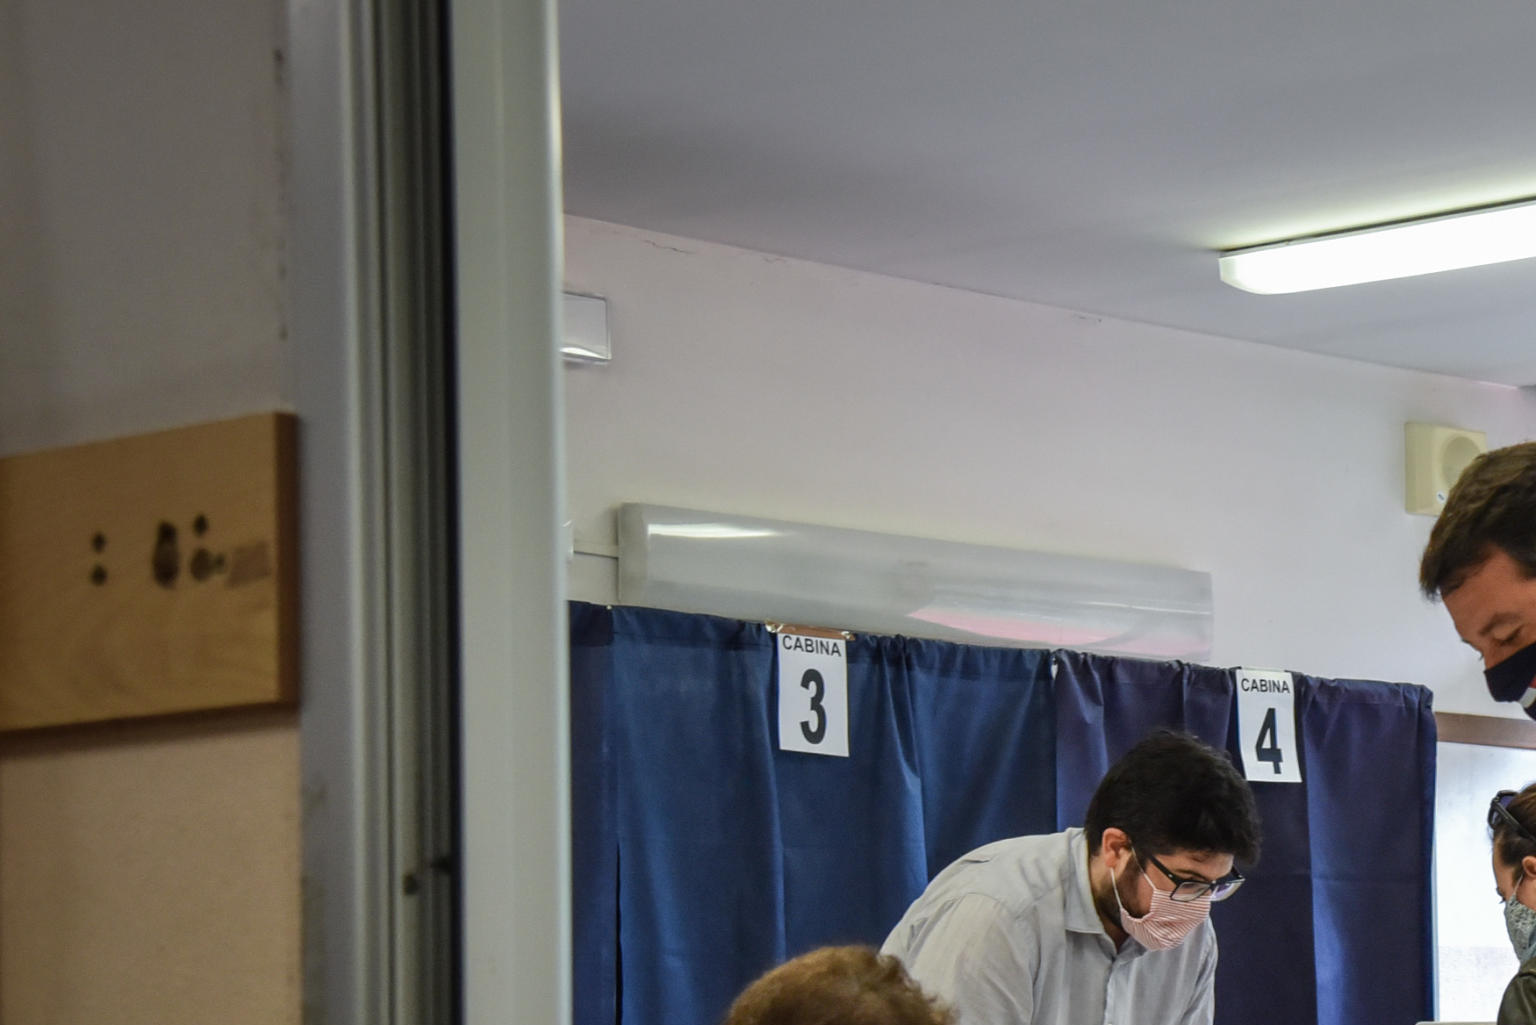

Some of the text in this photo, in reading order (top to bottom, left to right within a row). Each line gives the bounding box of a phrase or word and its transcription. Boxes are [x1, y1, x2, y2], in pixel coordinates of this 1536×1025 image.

[782, 634, 842, 657] CABINA
[799, 668, 827, 745] 3
[1240, 677, 1291, 694] CABINA
[1254, 707, 1283, 775] 4
